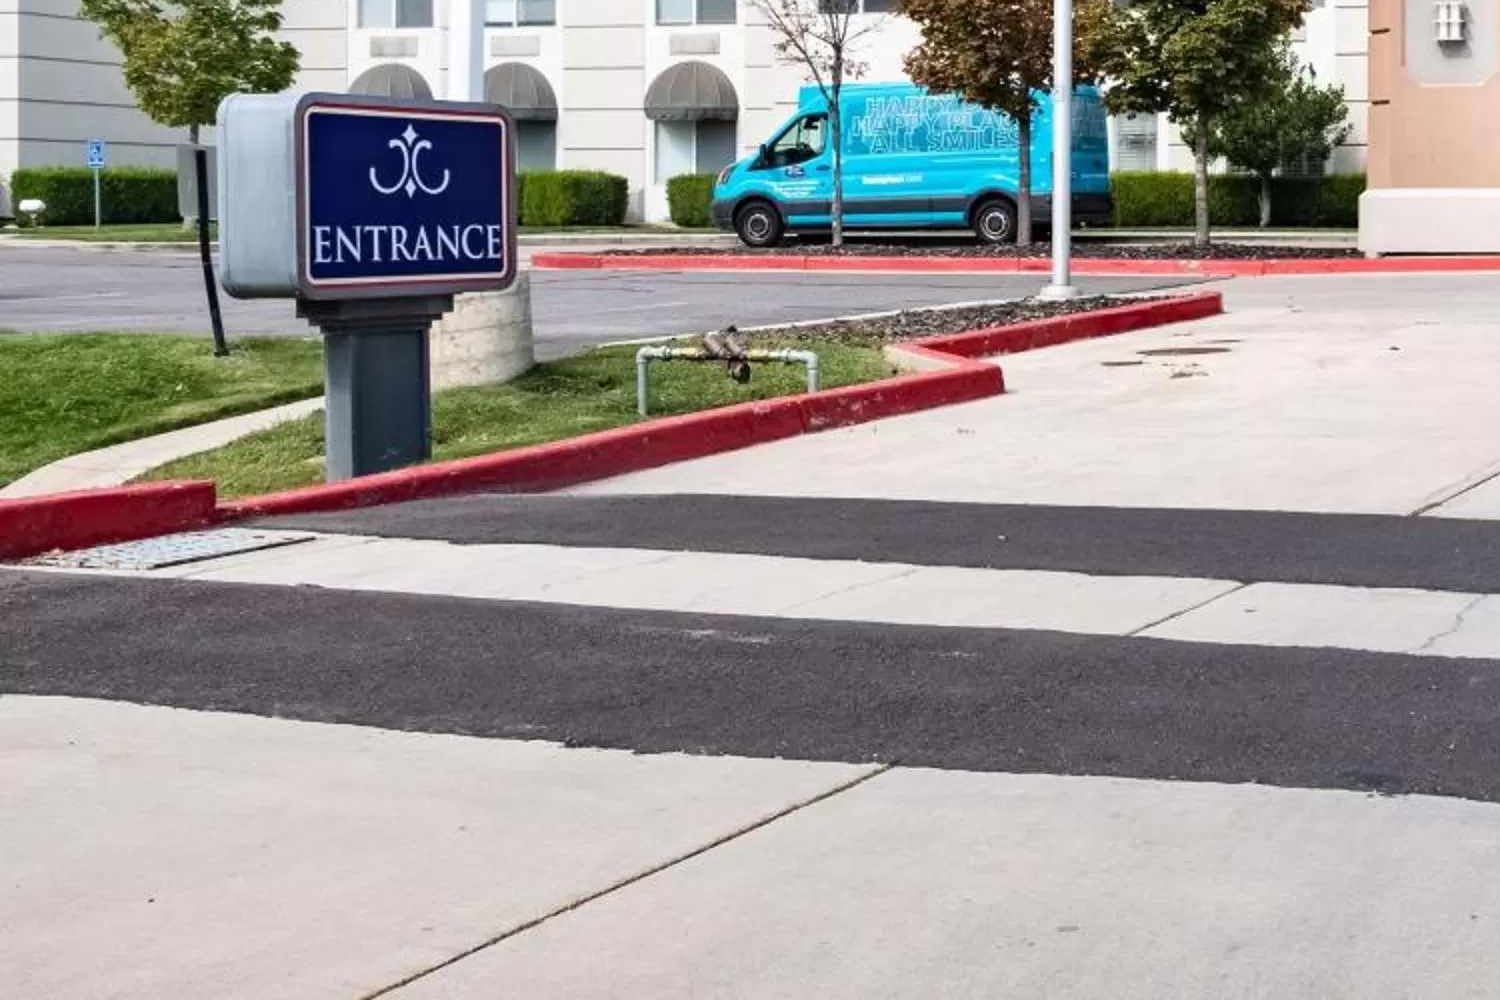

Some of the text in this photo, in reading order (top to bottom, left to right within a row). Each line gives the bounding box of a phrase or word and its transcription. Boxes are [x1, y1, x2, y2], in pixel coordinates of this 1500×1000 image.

[852, 112, 940, 137] HAPPY
[870, 131, 917, 153] ALL
[313, 224, 502, 264] ENTRANCE
